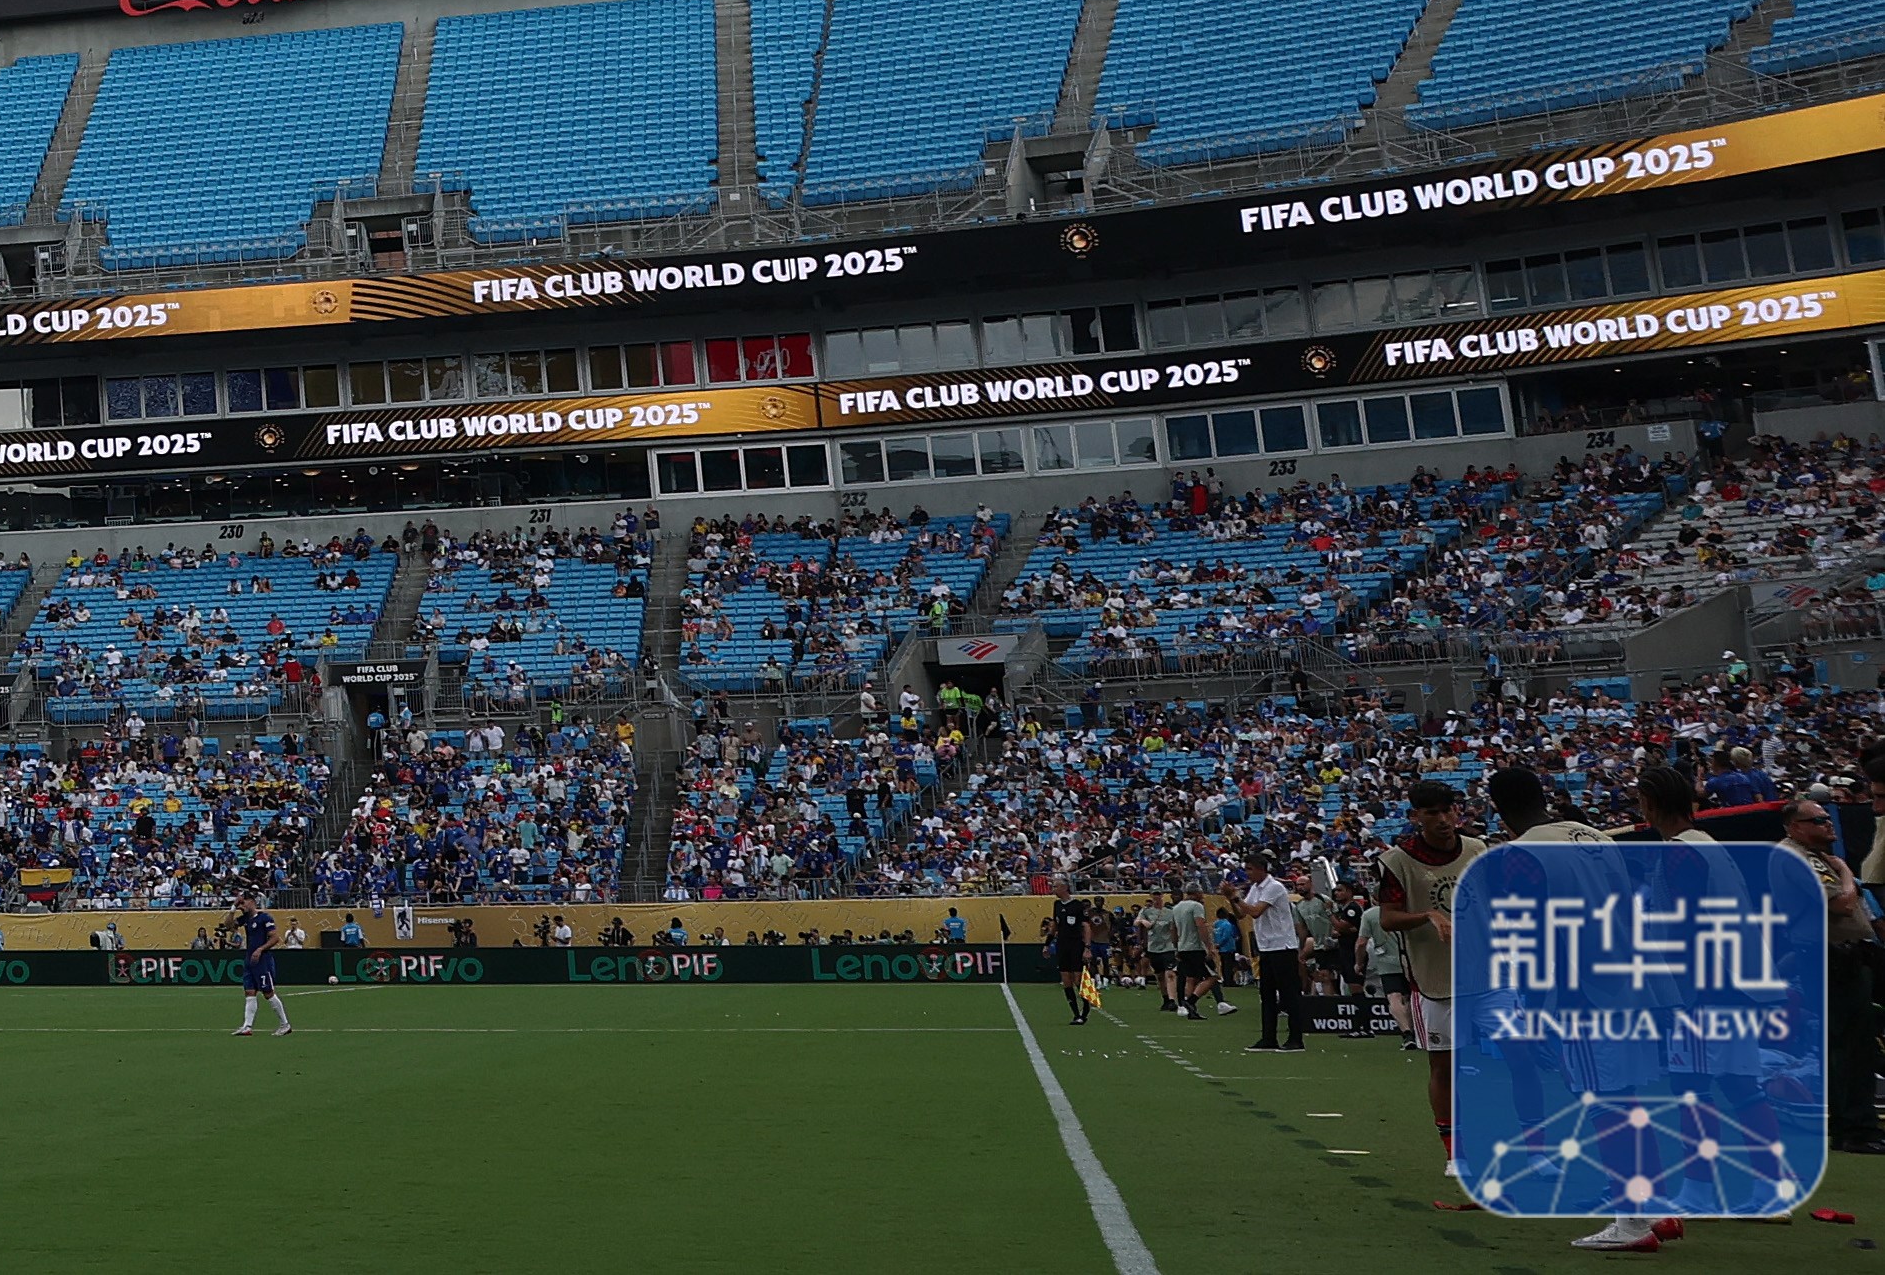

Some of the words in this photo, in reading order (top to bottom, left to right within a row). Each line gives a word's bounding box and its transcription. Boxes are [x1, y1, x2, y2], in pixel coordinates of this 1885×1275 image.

[1240, 201, 1315, 233] FIFA
[1320, 189, 1408, 222] CLUB
[1413, 169, 1538, 210] WORLD
[1545, 156, 1615, 190] CUP
[473, 277, 539, 303] FIFA
[544, 271, 624, 298] CLUB
[629, 262, 745, 292] WORLD
[752, 256, 818, 283] CUP
[33, 309, 90, 334] CUP
[1385, 338, 1454, 366] FIFA
[1459, 328, 1539, 358] CLUB
[1543, 314, 1659, 349] WORLD
[1665, 304, 1731, 334] CUP
[839, 389, 902, 415] FIFA
[905, 383, 980, 409] CLUB
[984, 374, 1094, 403] WORLD
[1100, 368, 1160, 393] CUP
[326, 422, 384, 445] FIFA
[388, 417, 457, 441] CLUB
[461, 411, 562, 437] WORLD
[567, 407, 623, 431] CUP
[80, 437, 132, 459] CUP
[1585, 431, 1615, 450] 234
[1268, 458, 1297, 476] 233
[529, 509, 552, 523] 231
[219, 523, 244, 539] 230
[342, 675, 374, 683] WORLD
[374, 674, 392, 682] CUP
[356, 666, 375, 674] FIFA
[376, 665, 398, 674] CLUB
[141, 957, 182, 979] PIF
[400, 955, 444, 977] PIF
[672, 954, 717, 976] PIF
[954, 951, 1002, 974] PIF
